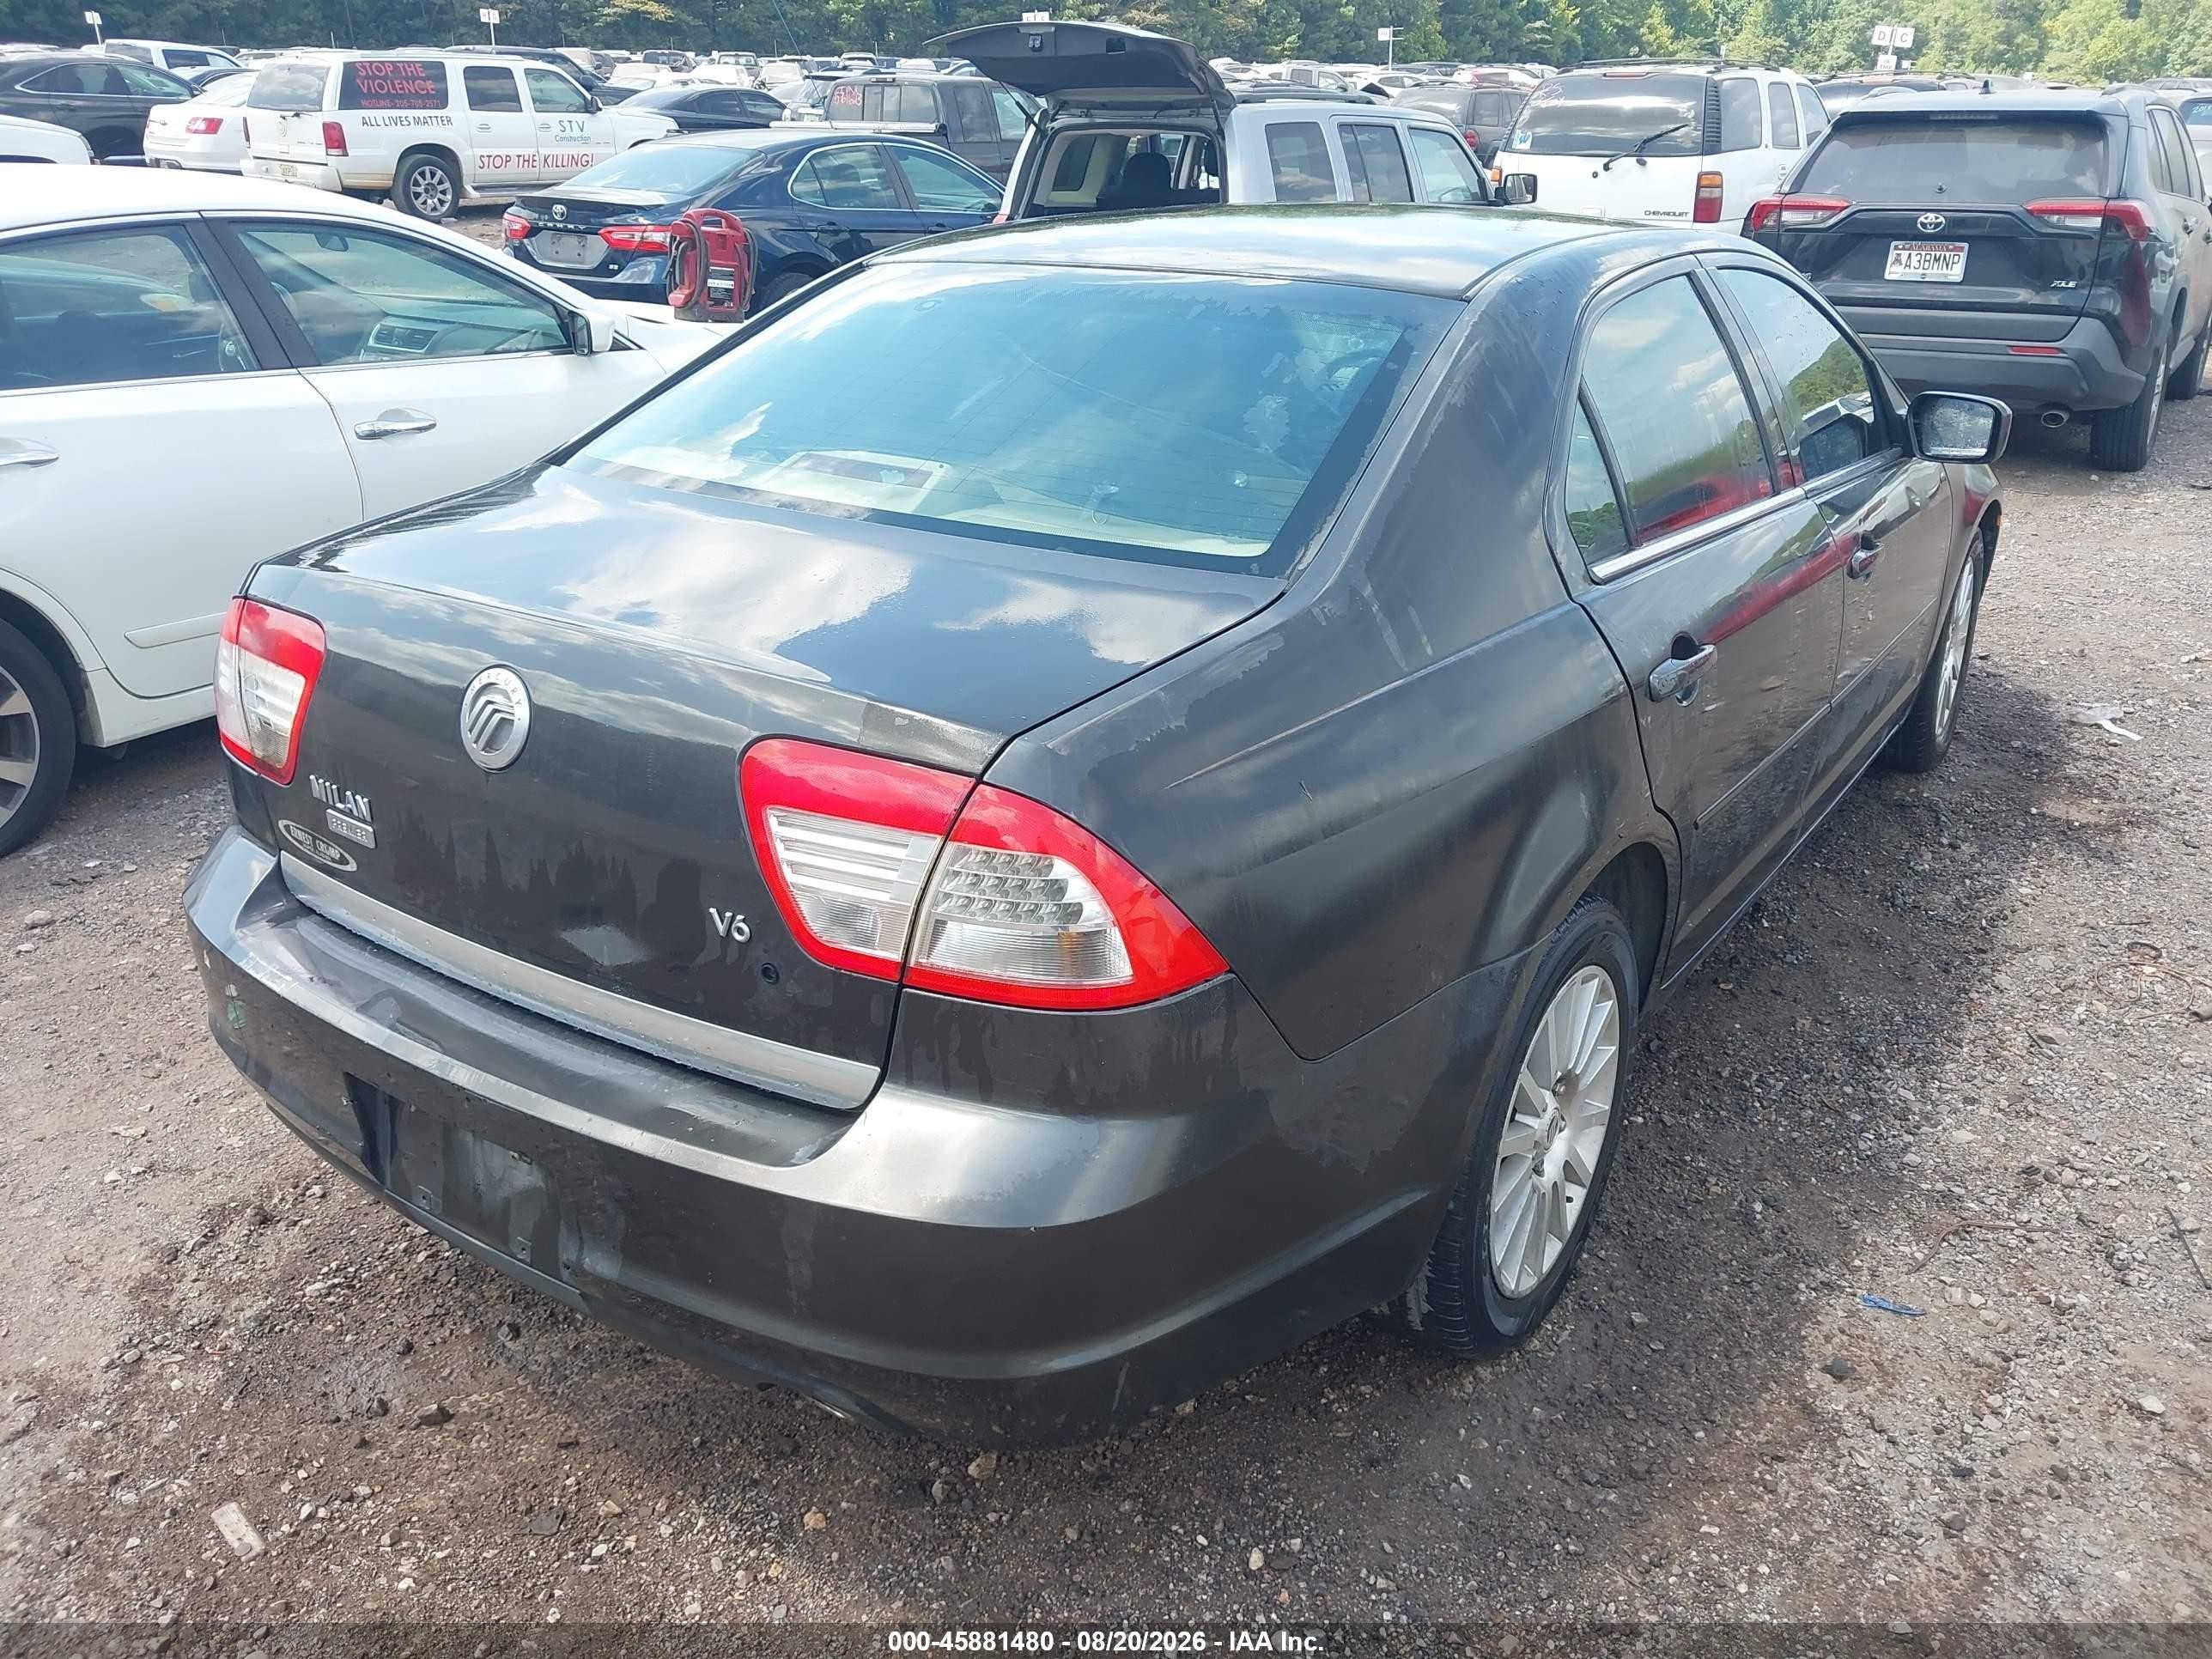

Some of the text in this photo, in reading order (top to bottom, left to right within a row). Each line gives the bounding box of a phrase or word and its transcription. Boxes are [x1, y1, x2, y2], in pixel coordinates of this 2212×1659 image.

[1878, 31, 1886, 40] D
[1900, 33, 1908, 43] C
[356, 63, 425, 76] STOP THE
[356, 80, 436, 94] VIOLENCE
[362, 116, 453, 127] ALL LIVES MATTER
[558, 120, 585, 133] STV
[478, 153, 594, 169] STOP THE KILLING!
[1903, 252, 1961, 271] A3BMNP
[470, 672, 523, 706] MERCURY
[309, 775, 373, 823] MILAN
[289, 824, 314, 848] ERNEST
[708, 907, 751, 943] V6
